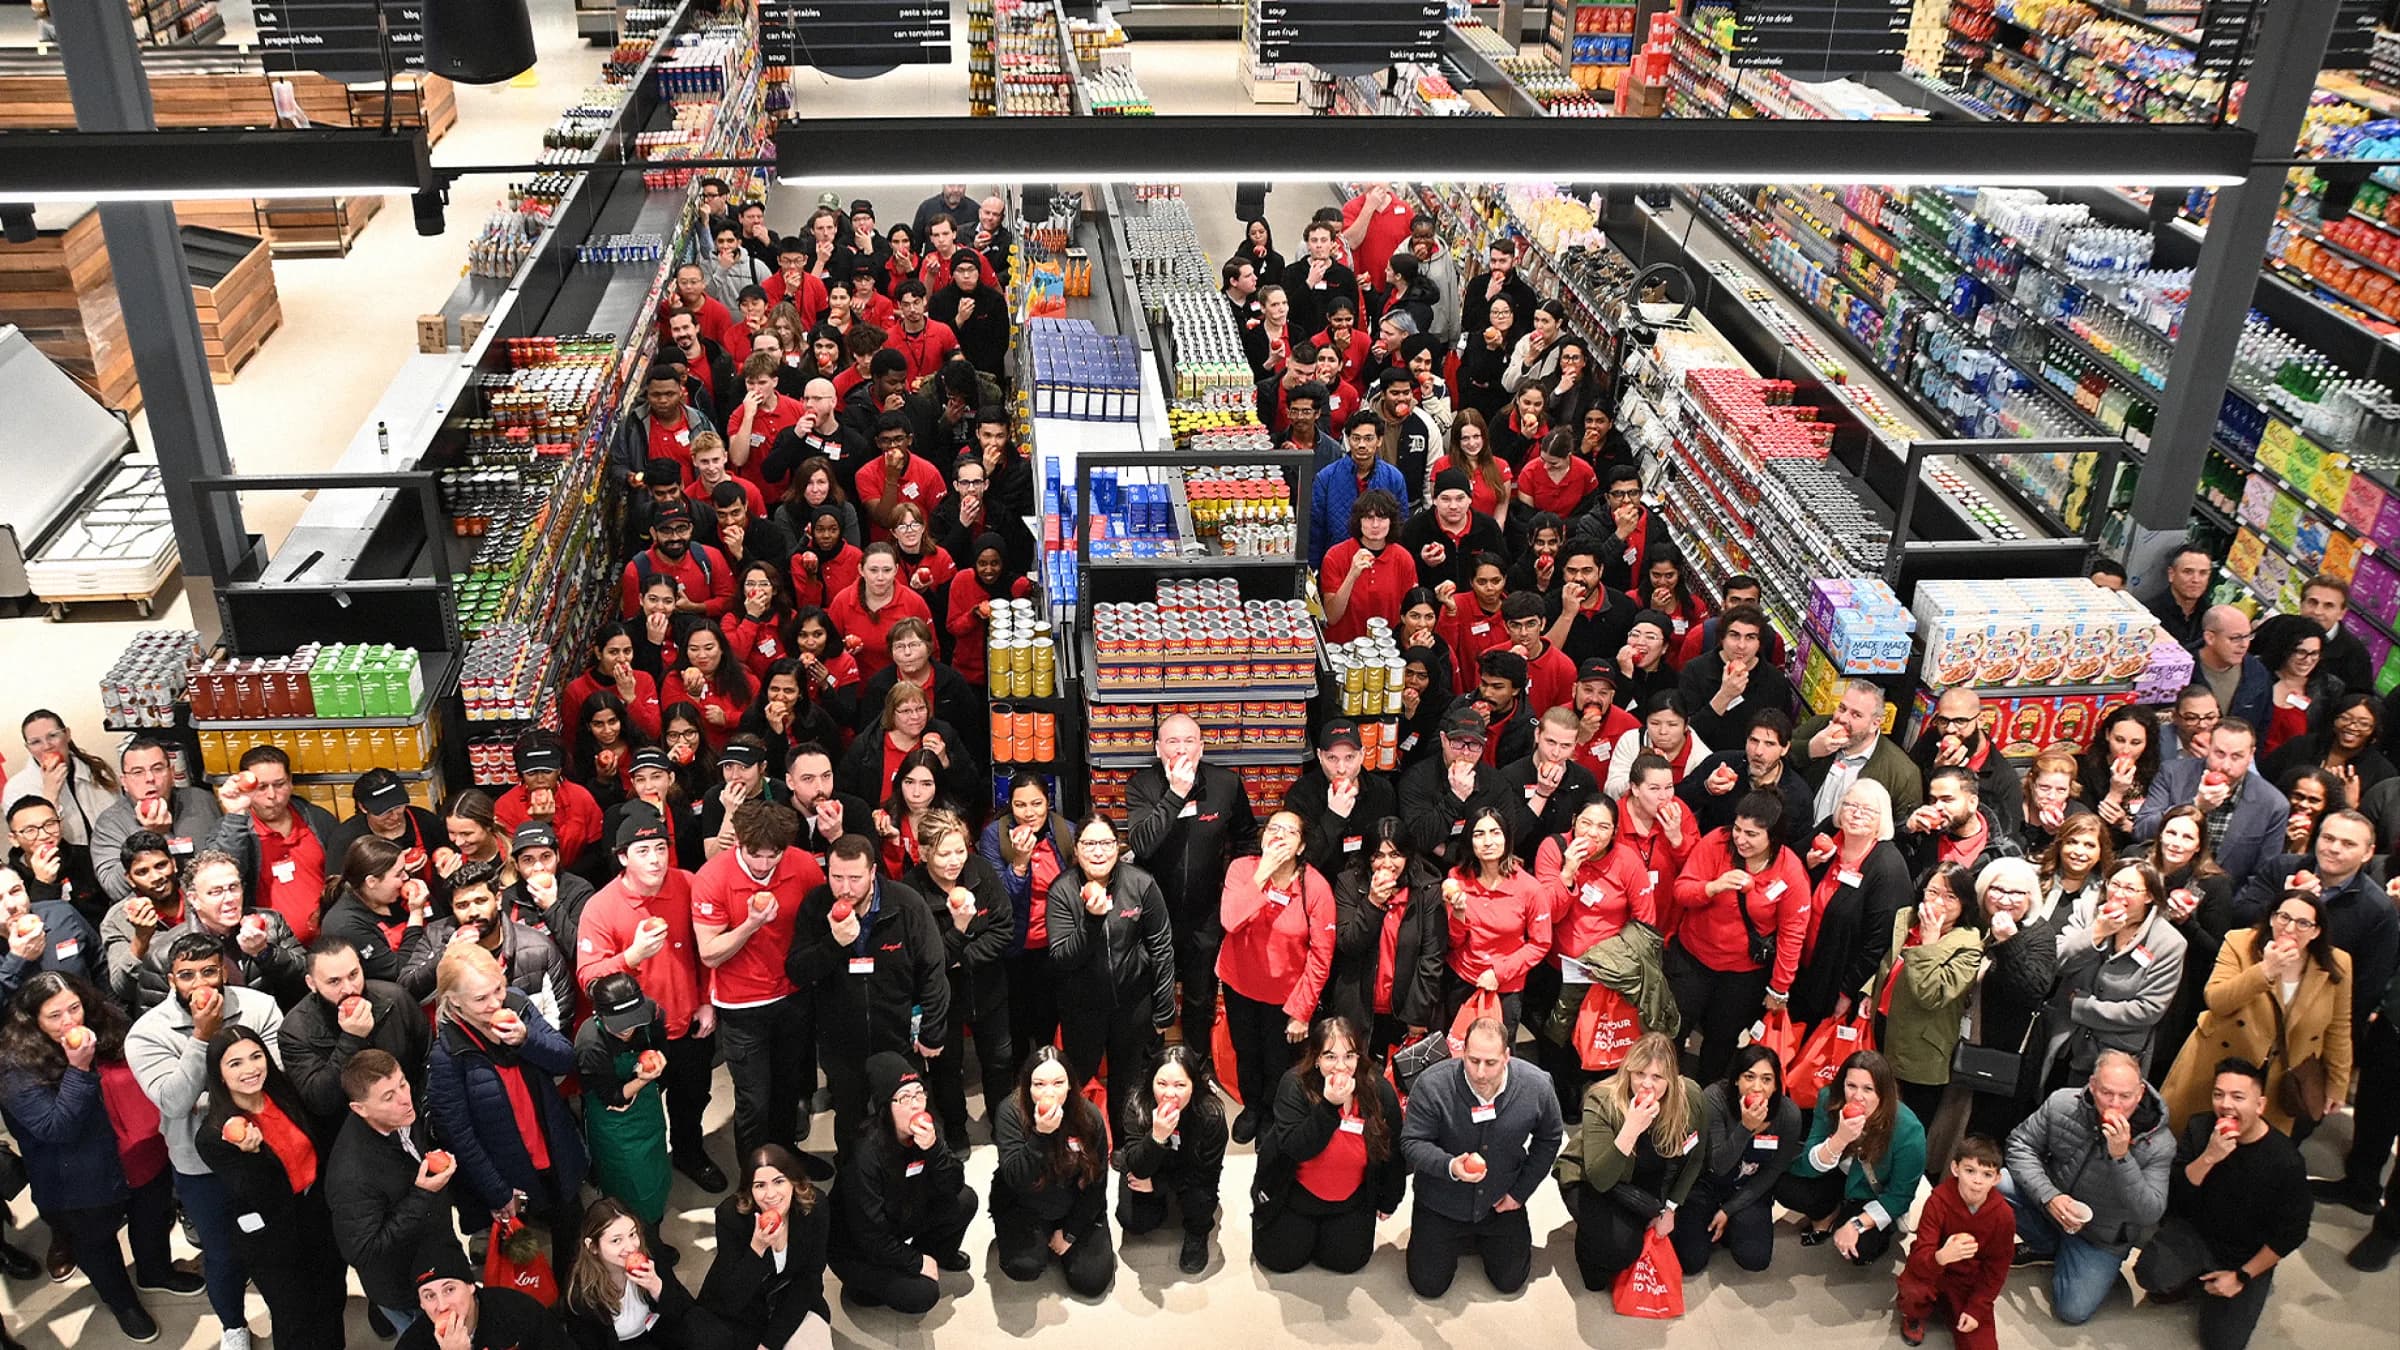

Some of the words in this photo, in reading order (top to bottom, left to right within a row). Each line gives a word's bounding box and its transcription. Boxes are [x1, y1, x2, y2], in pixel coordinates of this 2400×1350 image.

[780, 8, 821, 19] veetables
[899, 9, 920, 18] pasta
[922, 8, 944, 16] sauce
[1268, 8, 1287, 16] soup
[1423, 7, 1440, 15] flour
[392, 32, 412, 42] salad
[766, 32, 778, 40] can
[779, 30, 796, 40] fish
[893, 31, 907, 39] can
[908, 29, 945, 38] tomatoes
[1282, 28, 1299, 37] fruit
[1419, 29, 1440, 38] sugar
[264, 34, 300, 48] prepared
[301, 34, 323, 44] foods
[1741, 35, 1758, 43] wie
[768, 54, 786, 63] soup
[1267, 50, 1279, 58] foil
[1390, 51, 1414, 61] baking
[1415, 50, 1437, 58] needs
[405, 55, 424, 64] cond
[1738, 56, 1784, 65] nn-alcoholic
[1852, 640, 1879, 650] MADE
[1883, 640, 1911, 650] MADE
[2167, 663, 2191, 674] MADE
[1594, 1040, 1608, 1050] TO
[1632, 1283, 1644, 1292] TO
